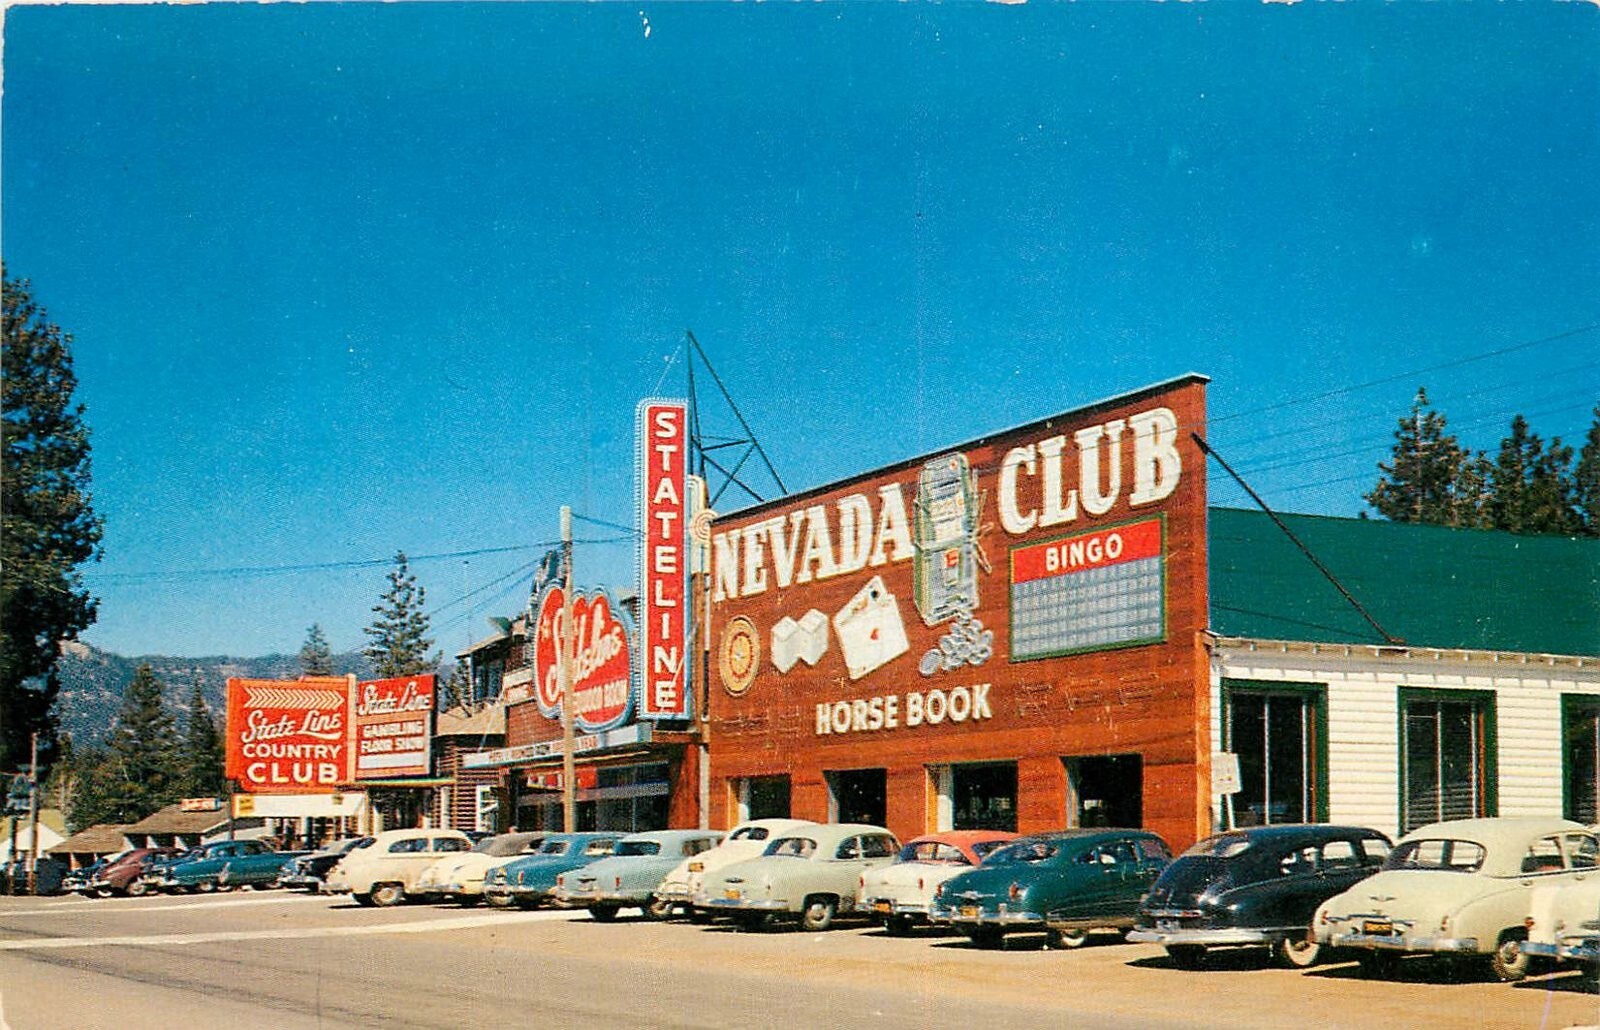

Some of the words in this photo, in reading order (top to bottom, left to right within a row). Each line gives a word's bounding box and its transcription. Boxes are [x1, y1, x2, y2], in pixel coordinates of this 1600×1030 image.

[713, 483, 915, 602] NEVADA
[998, 407, 1182, 535] CLUB
[652, 411, 680, 709] STATELINE
[1045, 533, 1123, 571] BINGO
[358, 684, 397, 715] State
[397, 681, 432, 711] Line
[815, 692, 900, 736] HORSE
[906, 683, 993, 727] BOOK
[241, 709, 296, 743] State
[298, 709, 342, 740] Line
[363, 721, 423, 738] GAMBLING
[242, 743, 342, 759] COUNTRY
[246, 762, 339, 784] CLUB
